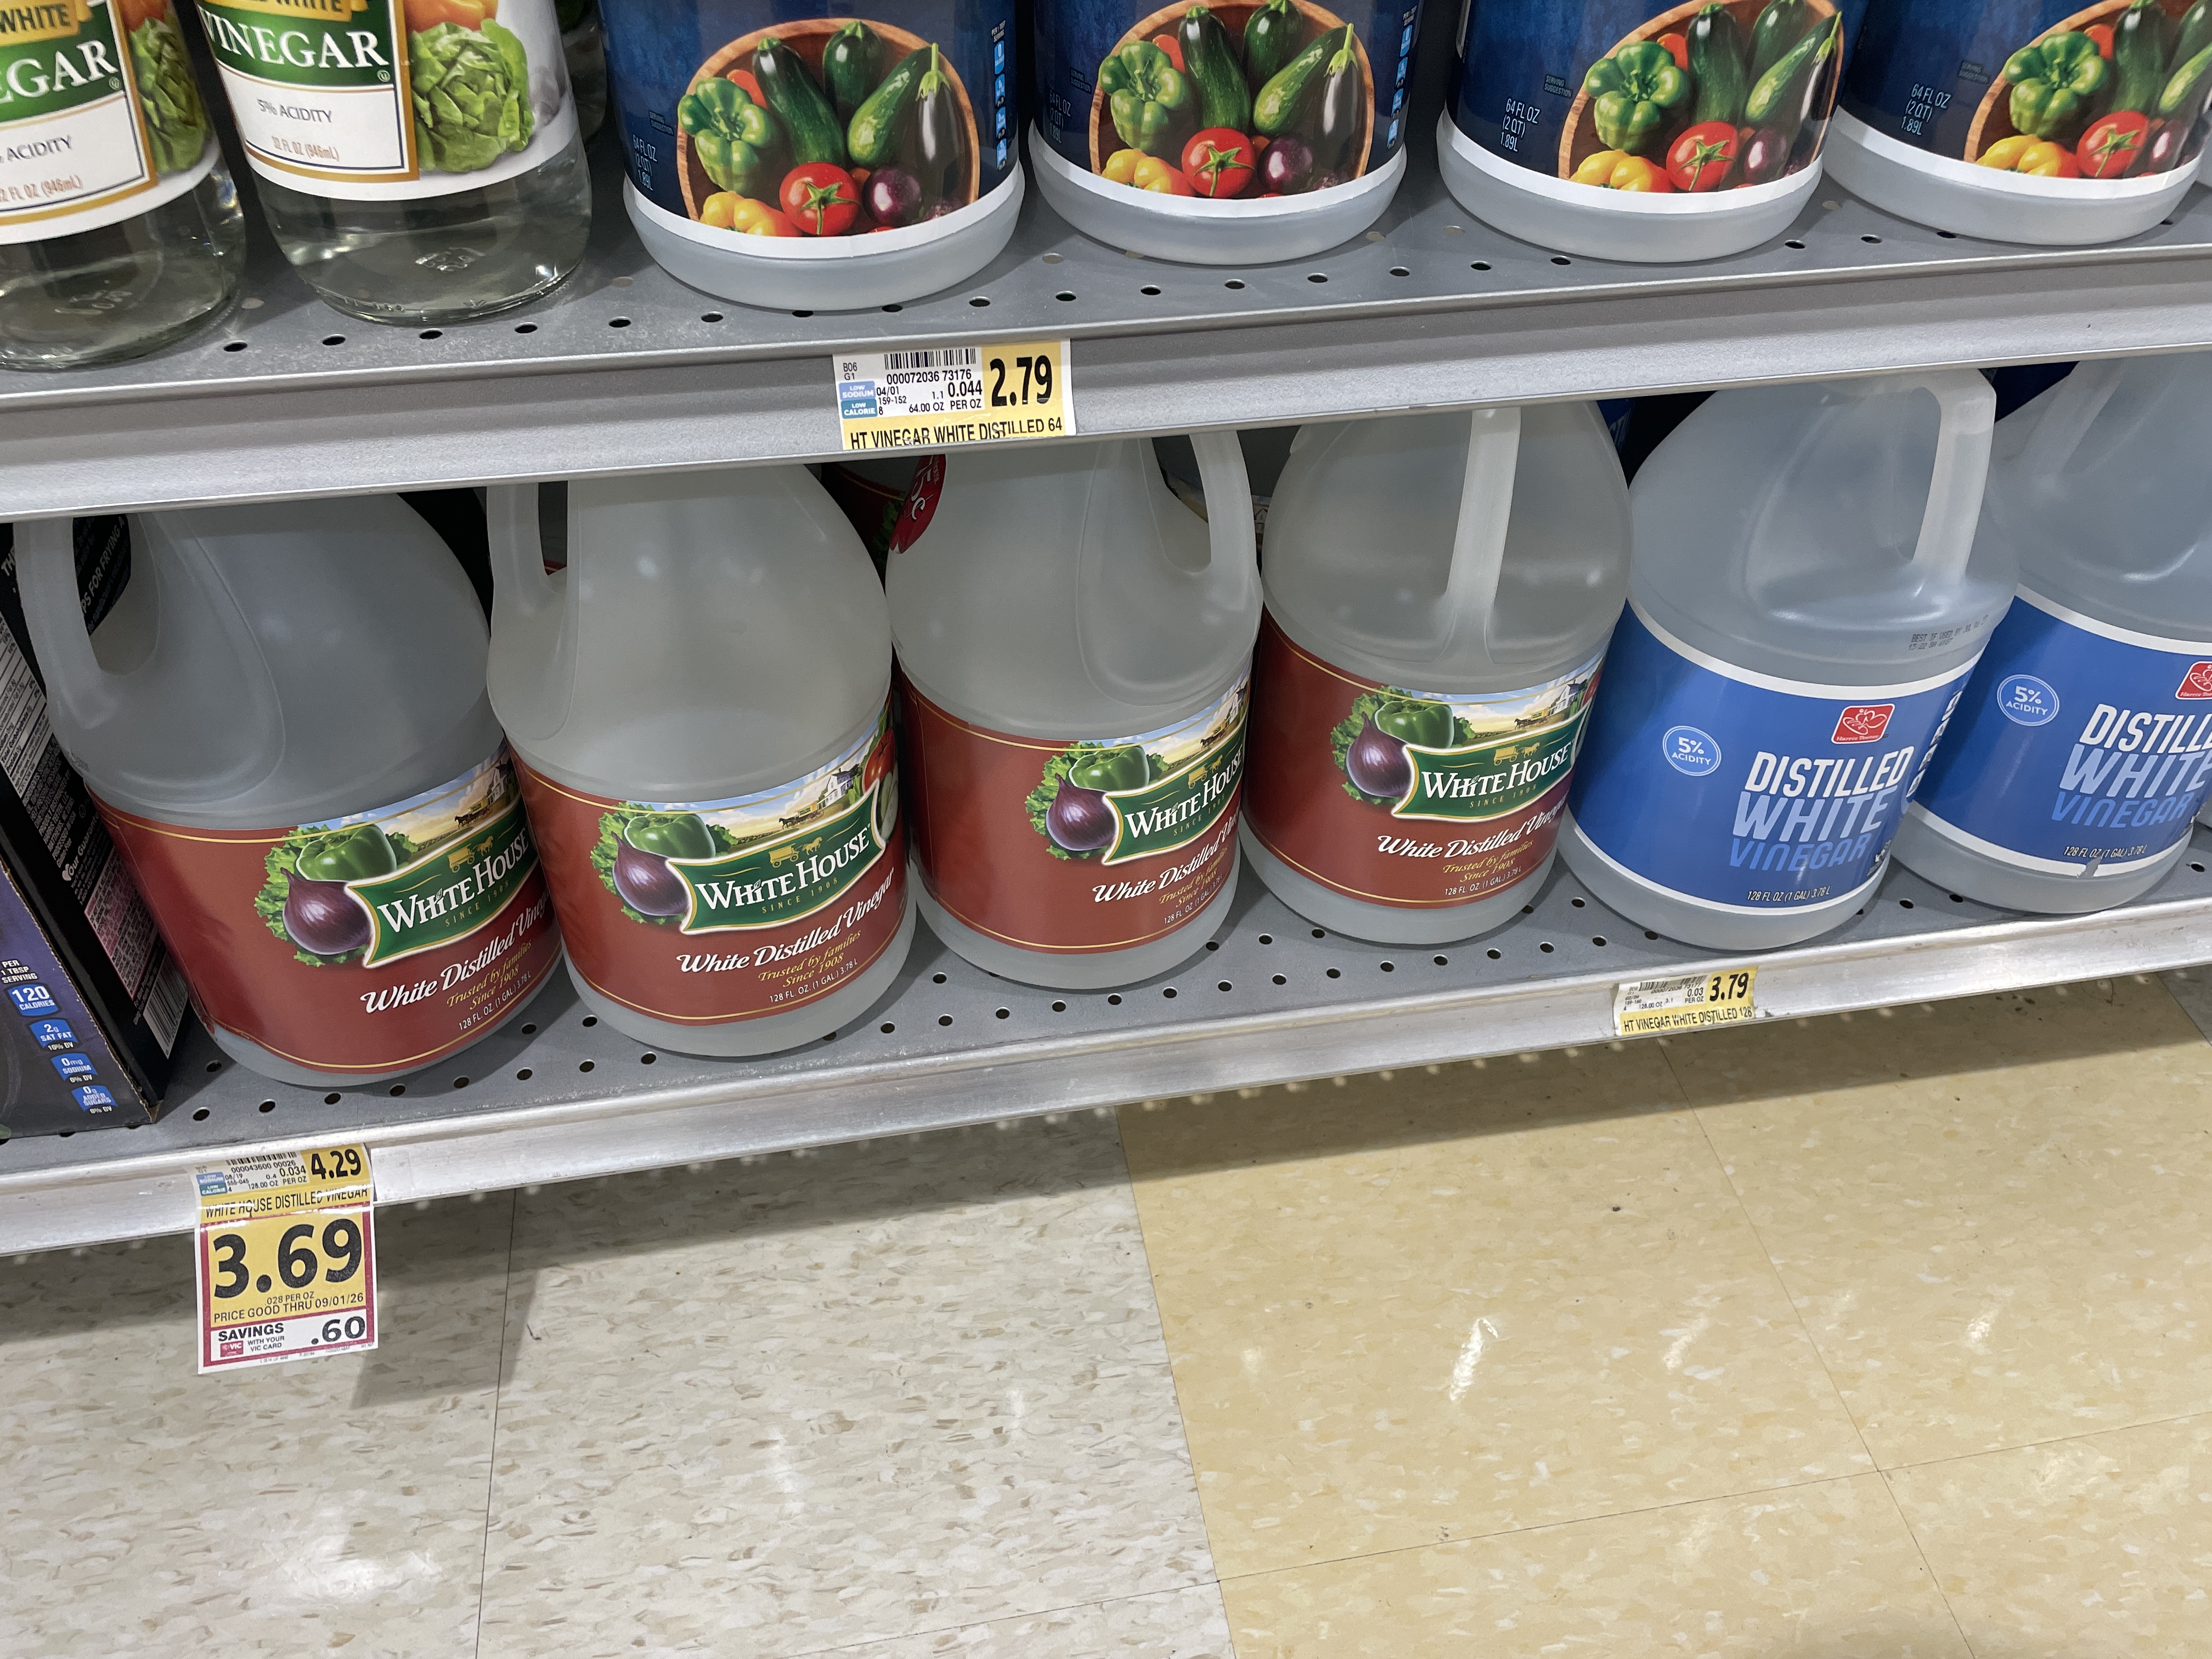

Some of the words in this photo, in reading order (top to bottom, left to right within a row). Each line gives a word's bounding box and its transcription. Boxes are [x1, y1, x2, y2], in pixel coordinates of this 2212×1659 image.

[197, 4, 390, 69] VINEGAR
[1911, 83, 1924, 99] 64
[1922, 87, 1934, 104] FL
[1934, 92, 1951, 109] OZ
[257, 98, 278, 116] 5%
[280, 105, 332, 123] ACIDITY
[1506, 98, 1516, 114] 64
[1516, 102, 1525, 119] FL
[1527, 106, 1540, 123] OZ
[1901, 116, 1922, 136] 1.89L
[7, 134, 72, 162] ACIDITY
[647, 143, 658, 162] OZ
[1500, 132, 1518, 152] 1.89L
[843, 363, 857, 372] B06
[886, 371, 939, 385] 000072036
[942, 369, 972, 381] 73176
[876, 386, 900, 397] 04/01
[948, 380, 983, 398] 0.044
[990, 355, 1052, 407] 2.79
[842, 390, 874, 398] SODIUM
[878, 396, 907, 405] 159-152
[950, 400, 968, 410] PER
[969, 399, 982, 408] OZ
[844, 407, 876, 416] CALORIE
[909, 403, 930, 413] 64.00
[933, 402, 945, 411] OZ
[850, 432, 868, 449] HT
[871, 427, 930, 448] VINEGAR
[933, 423, 975, 443] WHITE
[979, 419, 1045, 439] DISTILLED
[1048, 417, 1063, 432] 64
[1911, 634, 1927, 642] BEST
[2014, 685, 2042, 704] 5%
[2006, 701, 2048, 715] ACIDITY
[1678, 736, 1705, 755] 5%
[1421, 771, 1507, 799] WHITE
[1506, 740, 1571, 789] HOUSE
[1672, 751, 1712, 766] ACIDITY
[1744, 746, 1914, 798] DISTILLED
[2059, 743, 2212, 798] WHITE
[1125, 793, 1201, 838] WHITE
[1201, 743, 1243, 808] HOUSE
[1470, 795, 1505, 808] SINCE
[1733, 785, 1898, 843] WHITE
[2051, 792, 2194, 828] VINEGAR
[1173, 813, 1203, 836] SINCE
[1378, 835, 1443, 859] White
[1444, 821, 1527, 859] Distilled
[1729, 832, 1870, 872] VINEGAR
[2063, 846, 2079, 856] 128
[2078, 847, 2087, 857] FL
[2089, 848, 2101, 858] OZ
[695, 873, 796, 910] WHITE
[795, 831, 870, 890] HOUSE
[1092, 878, 1157, 904] White
[1158, 830, 1222, 890] Distilled
[1443, 857, 1487, 873] Trusted
[1486, 855, 1499, 867] by
[377, 879, 475, 933] WHITE
[472, 827, 529, 895] HOUSE
[1460, 869, 1489, 883] Since
[761, 895, 801, 914] SINCE
[811, 877, 838, 897] 1908
[1159, 876, 1195, 904] Trusted
[1176, 887, 1199, 908] Since
[1445, 887, 1457, 895] 128
[1747, 890, 1760, 901] 128
[1762, 891, 1770, 901] FL
[1773, 891, 1784, 901] OZ
[1785, 891, 1792, 902] (1
[1794, 890, 1810, 901] GAL)
[1812, 887, 1825, 898] 3.78
[1825, 886, 1830, 895] L
[445, 901, 480, 927] SINCE
[676, 953, 750, 974] White
[753, 914, 843, 967] Distilled
[843, 867, 895, 928] Vinegar
[1164, 913, 1174, 924] 128
[2, 960, 20, 968] PER
[758, 957, 807, 981] Trusted
[808, 954, 821, 968] by
[820, 929, 861, 964] families
[2, 973, 37, 984] SERVING
[360, 979, 438, 1014] White
[440, 921, 516, 991] Distilled
[447, 973, 490, 1008] Trusted
[490, 968, 501, 984] by
[500, 939, 532, 978] families
[782, 969, 815, 988] Since
[818, 952, 844, 974] 1908
[470, 986, 496, 1010] Since
[499, 964, 519, 989] 1908
[770, 993, 784, 1003] 128
[798, 984, 811, 995] OZ.
[840, 961, 854, 975] 3.78
[1687, 988, 1703, 997] 0.03
[1709, 973, 1748, 1002] 3.79
[12, 986, 50, 1003] 120
[19, 1000, 55, 1011] CALORIES
[459, 1019, 472, 1031] 128
[483, 1003, 494, 1015] OZ.
[1624, 1020, 1634, 1032] HT
[1636, 1015, 1671, 1031] VINEGAR
[1672, 1013, 1696, 1026] WHITE
[1699, 1008, 1737, 1023] DISTILLED
[1739, 1006, 1752, 1018] 128
[41, 1034, 56, 1042] SAT
[57, 1031, 72, 1040] FAT
[279, 1165, 306, 1177] 0.034
[311, 1148, 361, 1180] 4.29
[238, 1198, 272, 1214] HOUSE
[275, 1192, 323, 1209] DISTILLED
[213, 1218, 362, 1299] 3.69
[285, 1294, 301, 1302] PER
[303, 1291, 314, 1300] OZ
[214, 1310, 245, 1323] PRICE
[247, 1306, 280, 1318] GOOD
[283, 1300, 312, 1313] THRU
[315, 1293, 363, 1308] 09/01/26
[218, 1323, 284, 1342] SAVINGS
[311, 1316, 365, 1345] .60
[229, 1342, 242, 1350] VIC
[263, 1342, 282, 1351] CARD
